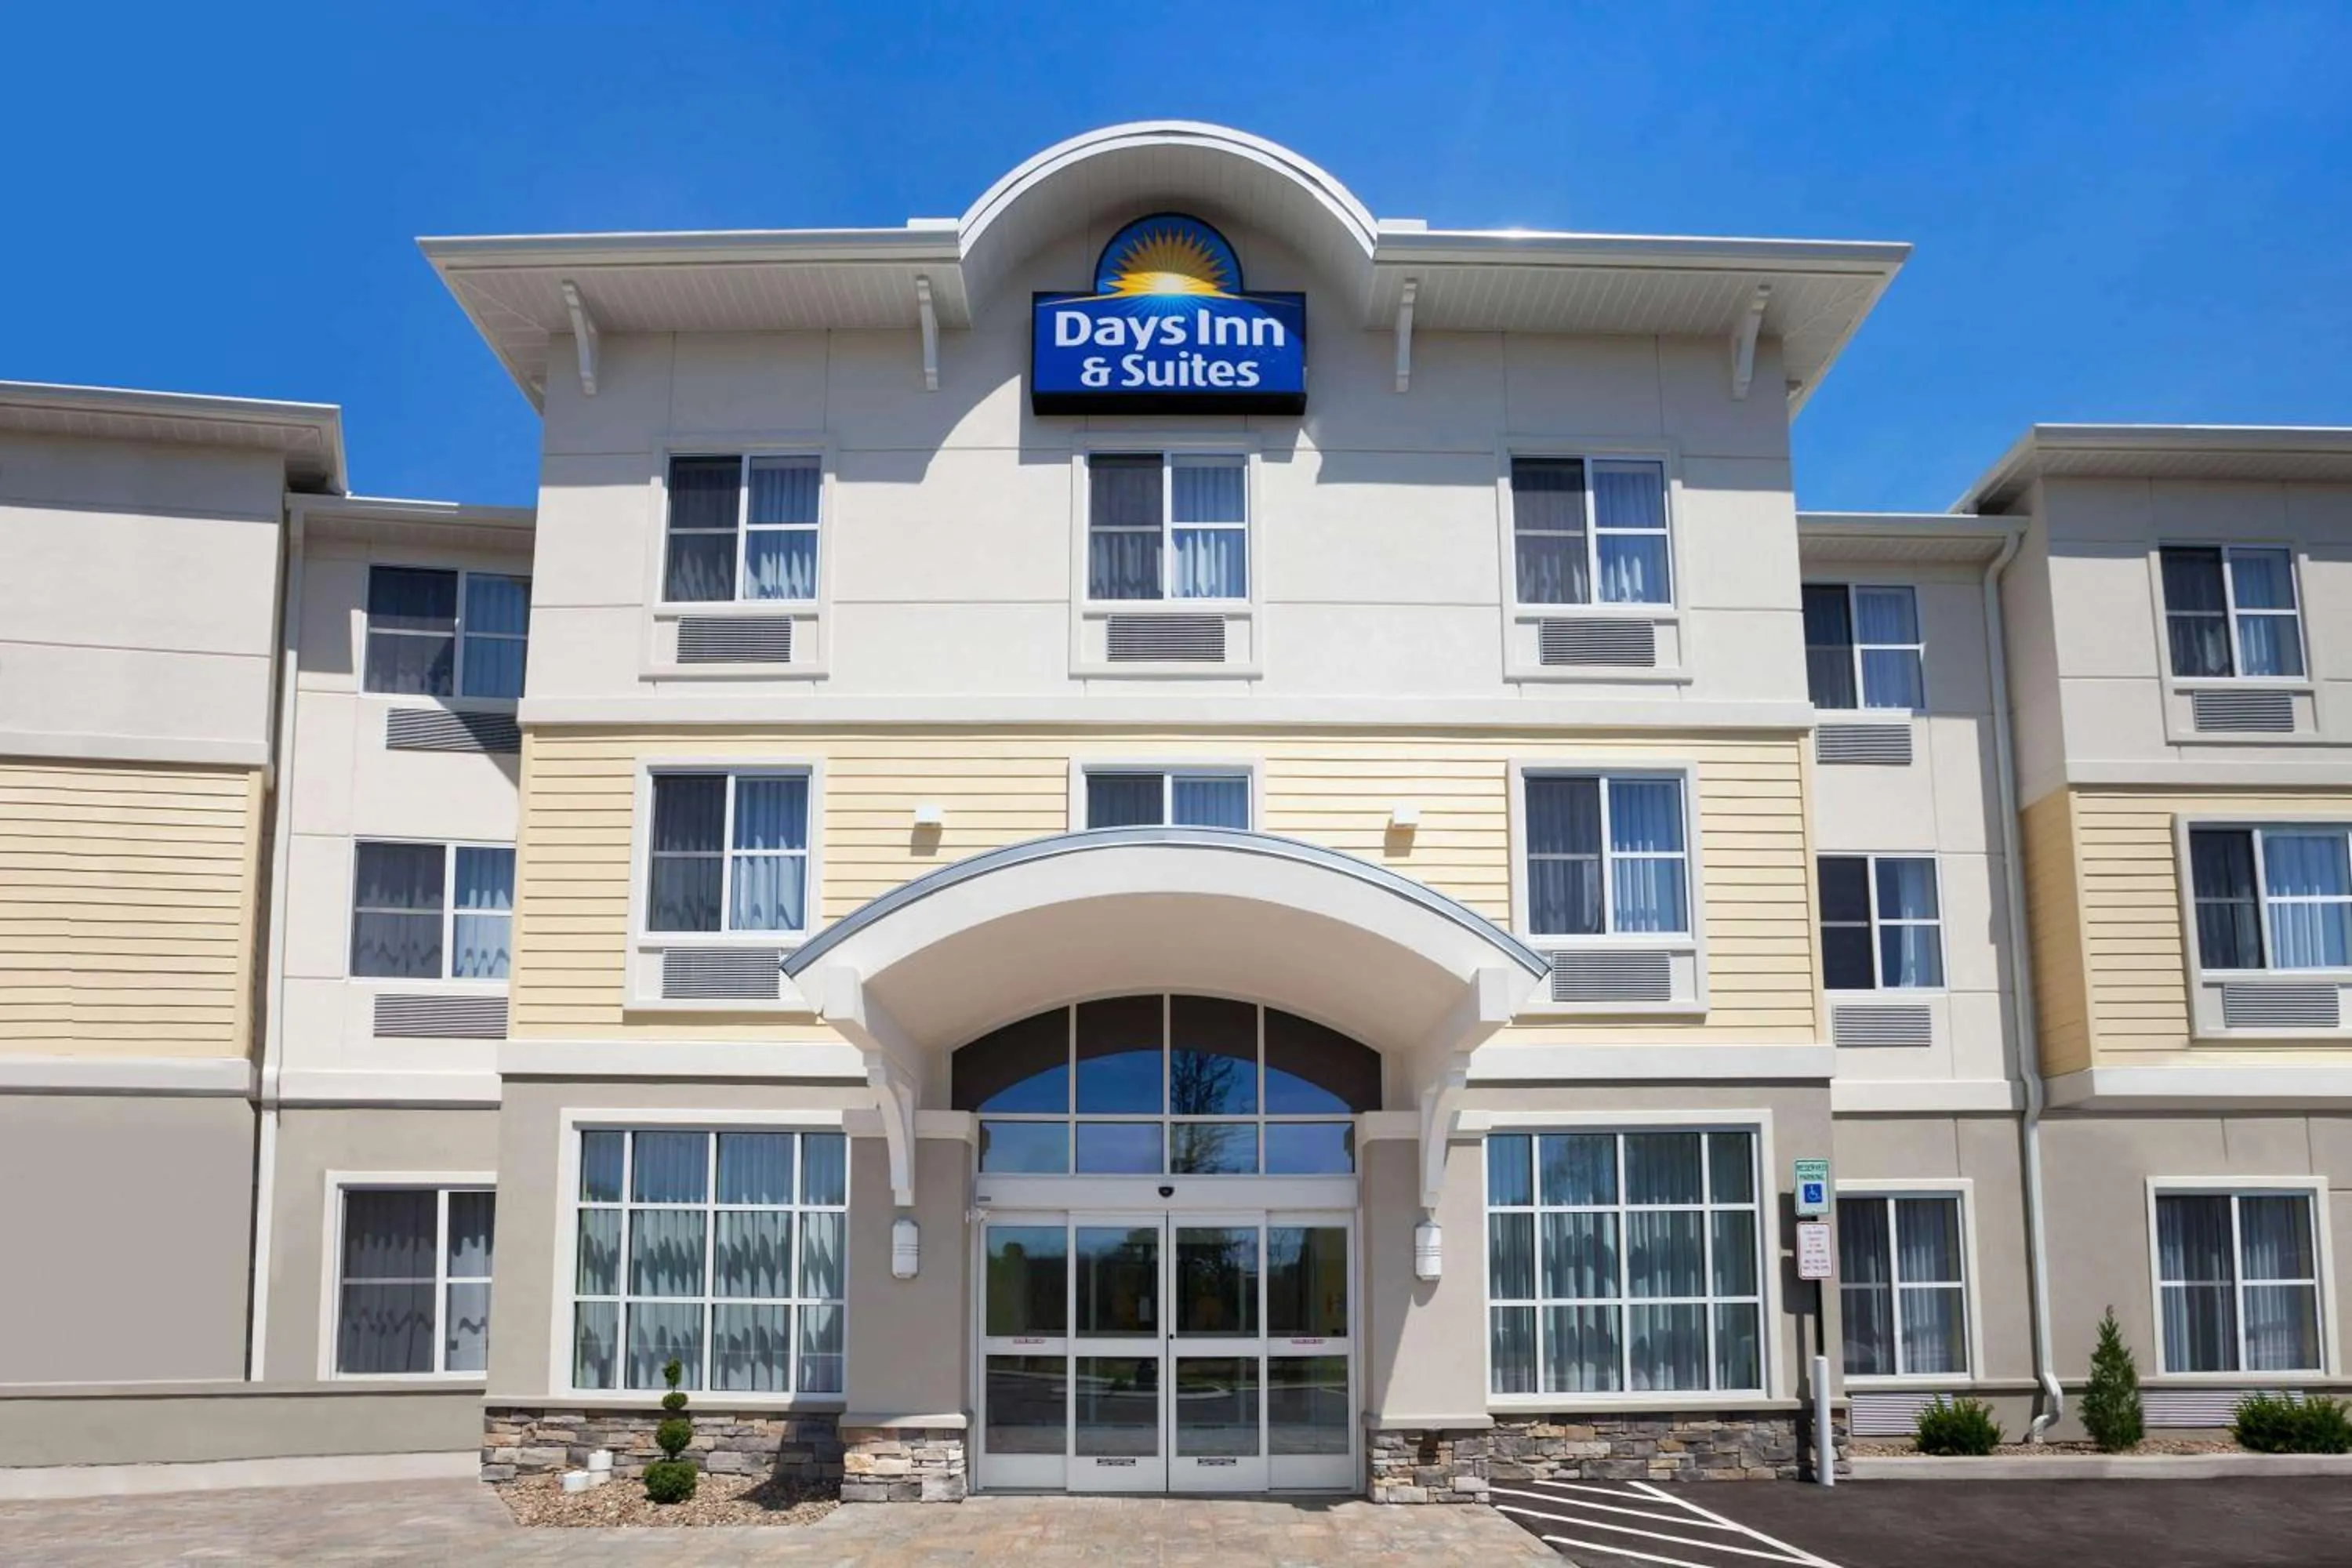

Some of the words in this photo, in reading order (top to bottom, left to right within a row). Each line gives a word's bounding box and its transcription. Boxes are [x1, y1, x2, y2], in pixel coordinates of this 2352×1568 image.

[1054, 310, 1186, 350] Days
[1196, 309, 1285, 347] Inn
[1080, 357, 1112, 387] &
[1121, 350, 1261, 387] Suites
